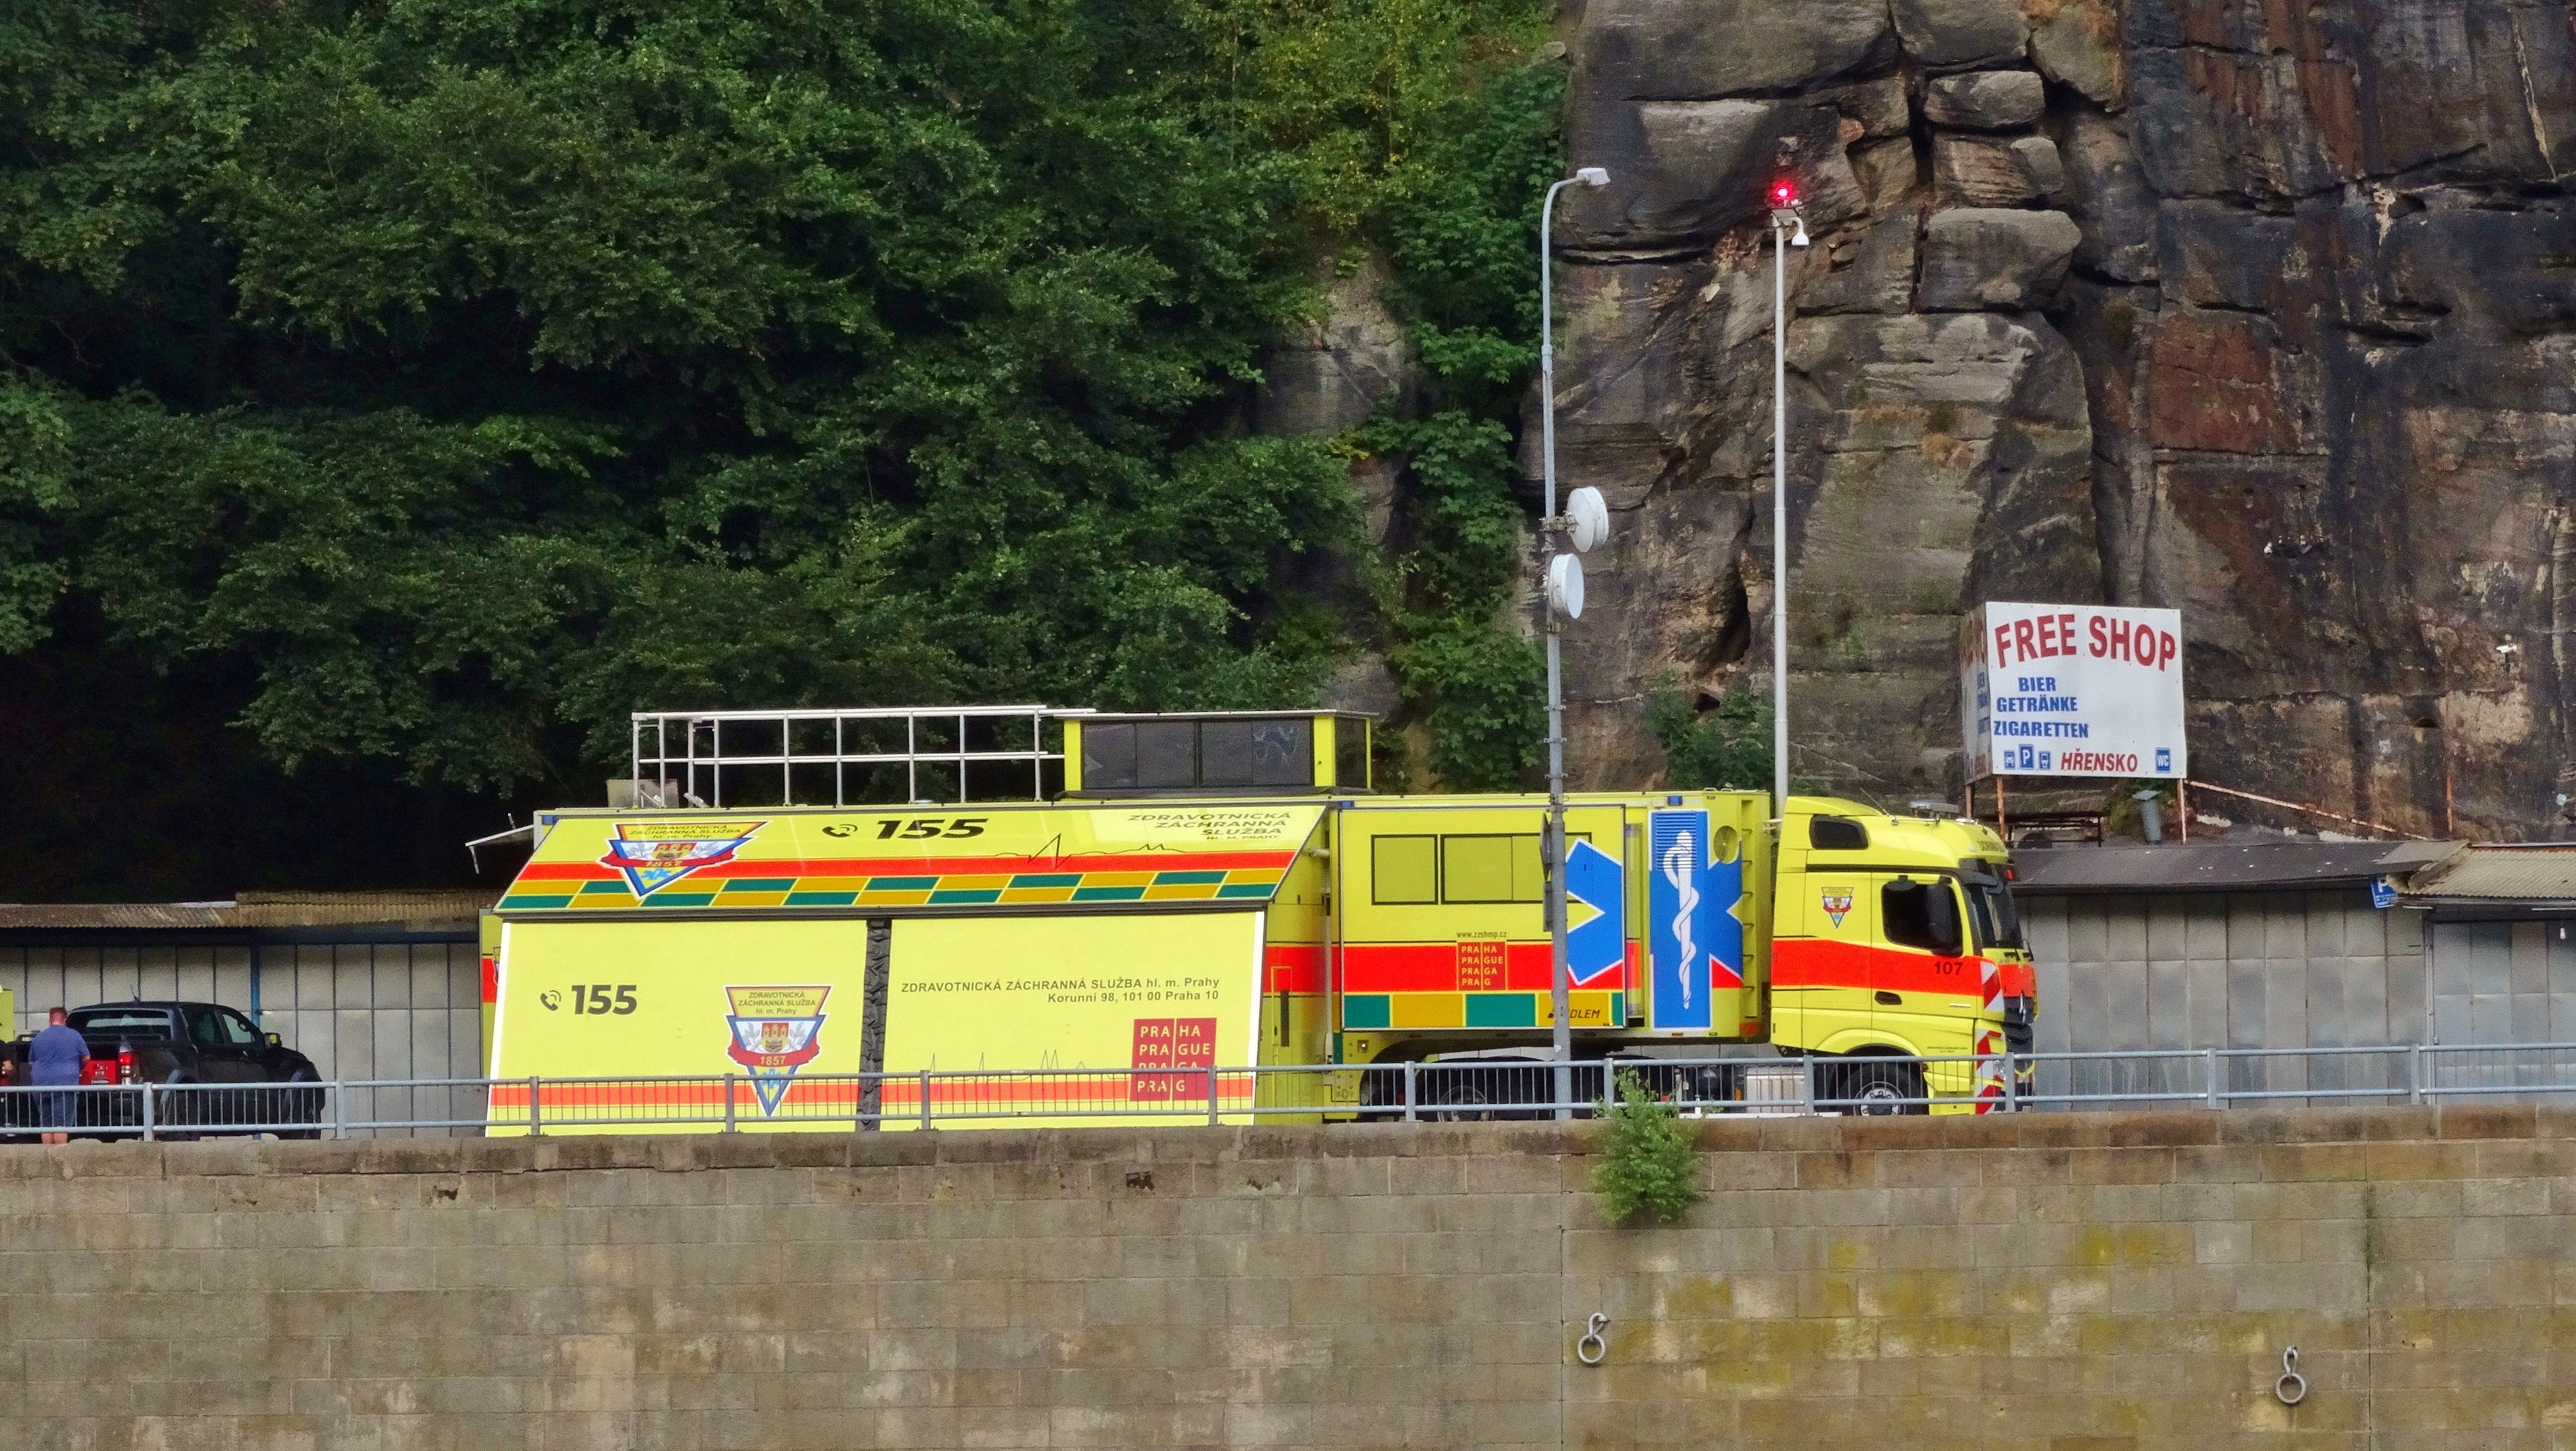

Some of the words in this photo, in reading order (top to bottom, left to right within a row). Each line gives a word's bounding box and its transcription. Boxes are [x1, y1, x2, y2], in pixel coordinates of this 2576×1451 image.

[1995, 614, 2077, 669] FREE
[2088, 615, 2176, 672] SHOP
[2018, 677, 2057, 693] BIER
[1997, 695, 2077, 712] GETRÄNKE
[1993, 720, 2089, 738] ZIGARETTEN
[2060, 748, 2137, 772] HŘENSKO
[2157, 755, 2169, 766] WC
[1127, 811, 1291, 821] ZDRAVOTNICKÁ
[876, 818, 988, 839] 155
[1155, 820, 1286, 828] ZÁCHRANNÁ
[1201, 828, 1281, 836] SLUŽBA
[1934, 961, 1963, 975] 107
[901, 979, 1001, 992] ZDRAVOTNICKÁ
[1006, 978, 1086, 991] ZÁCHRANNÁ
[1091, 977, 1142, 989] SLUŽBA
[1146, 979, 1160, 987] hl.
[1166, 979, 1179, 987] m.
[1185, 977, 1219, 988] Prahy
[571, 985, 637, 1015] 155
[748, 991, 805, 999] ZDRAVOTNICKÁ
[1048, 992, 1097, 1003] Korunní
[1101, 992, 1118, 1003] 98,
[1123, 992, 1142, 1002] 101
[1147, 992, 1161, 1001] 00
[1166, 991, 1201, 1001] Praha
[1205, 990, 1219, 1000] 10
[786, 998, 816, 1006] SLUŽBA
[1568, 1010, 1600, 1018] OLEM
[1140, 1025, 1170, 1037] PRA
[1179, 1025, 1201, 1037] HA
[1139, 1044, 1169, 1055] PRA
[1178, 1043, 1210, 1055] GUE
[760, 1055, 786, 1066] 1857
